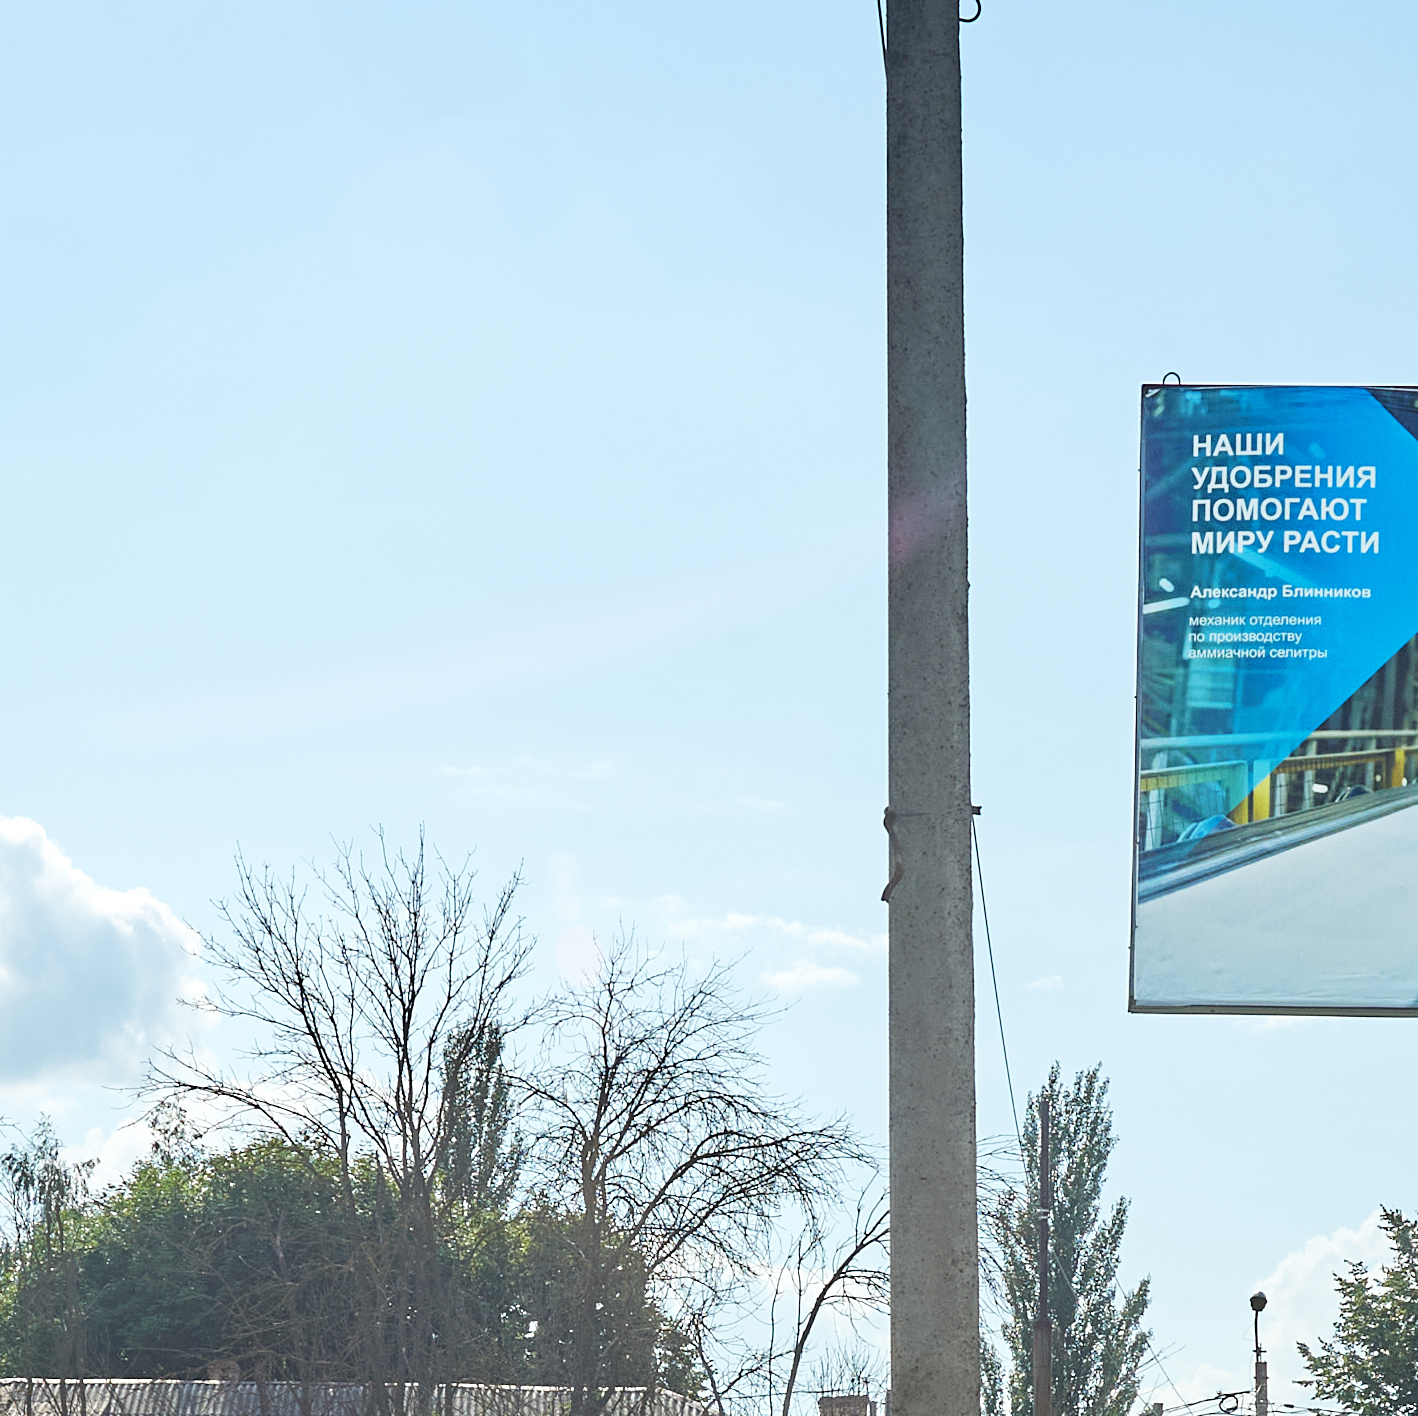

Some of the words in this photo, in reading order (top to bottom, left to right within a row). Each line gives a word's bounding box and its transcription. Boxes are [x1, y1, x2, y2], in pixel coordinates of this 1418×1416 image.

[1192, 432, 1284, 457] НАШИ
[1191, 465, 1376, 493] УДОБРЕНИЯ
[1191, 498, 1368, 522] ПОМОГАЮТ
[1191, 530, 1274, 554] МИРУ
[1283, 530, 1380, 554] РАСТИ
[1190, 585, 1278, 600] Александр
[1282, 585, 1372, 598] Блинников
[1189, 616, 1246, 626] механик
[1249, 616, 1322, 627] отделения
[1188, 632, 1205, 642] по
[1209, 632, 1303, 645] производству
[1188, 647, 1266, 659] аммиачной
[1269, 648, 1328, 660] селитры
